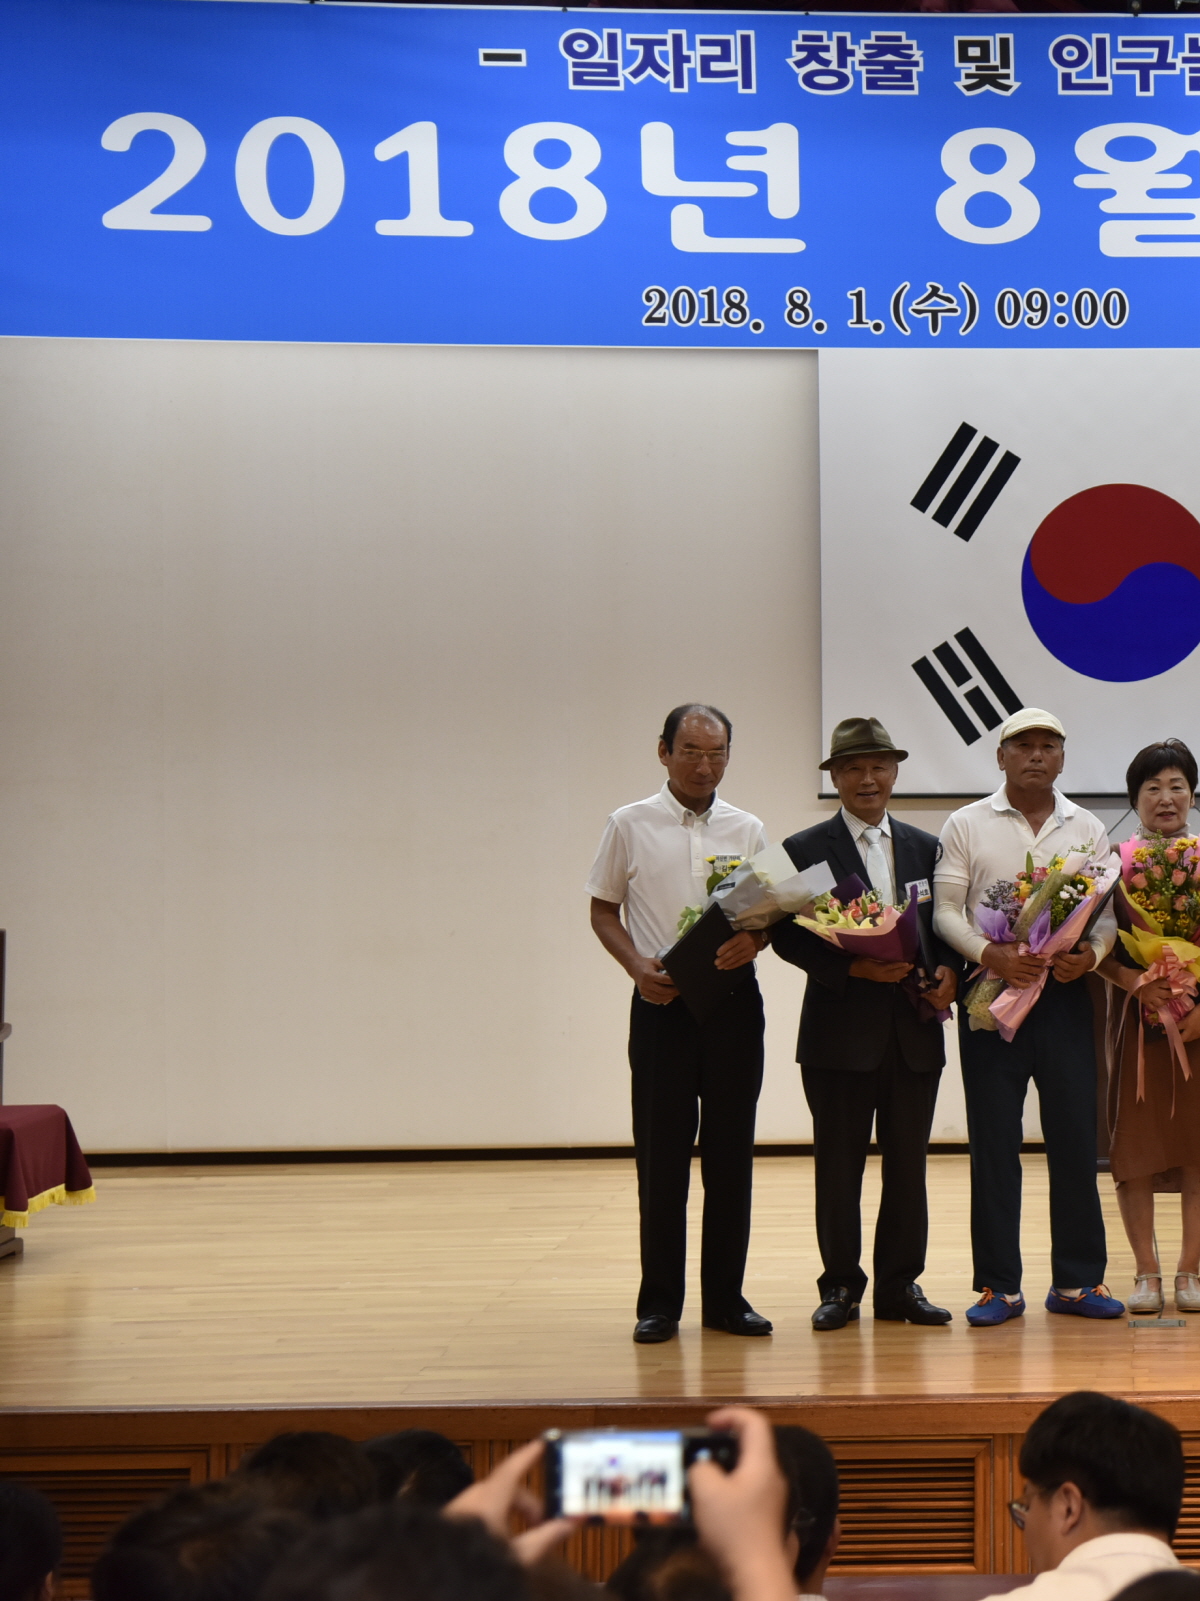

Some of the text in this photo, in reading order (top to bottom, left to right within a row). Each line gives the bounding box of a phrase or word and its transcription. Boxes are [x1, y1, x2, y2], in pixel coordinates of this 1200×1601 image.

[559, 29, 756, 93] 일자리
[787, 31, 924, 95] 창출
[954, 34, 1021, 96] 및
[102, 113, 806, 253] 2018년
[642, 286, 764, 333] 2018.
[785, 287, 827, 334] 8.
[995, 288, 1129, 329] 09:00
